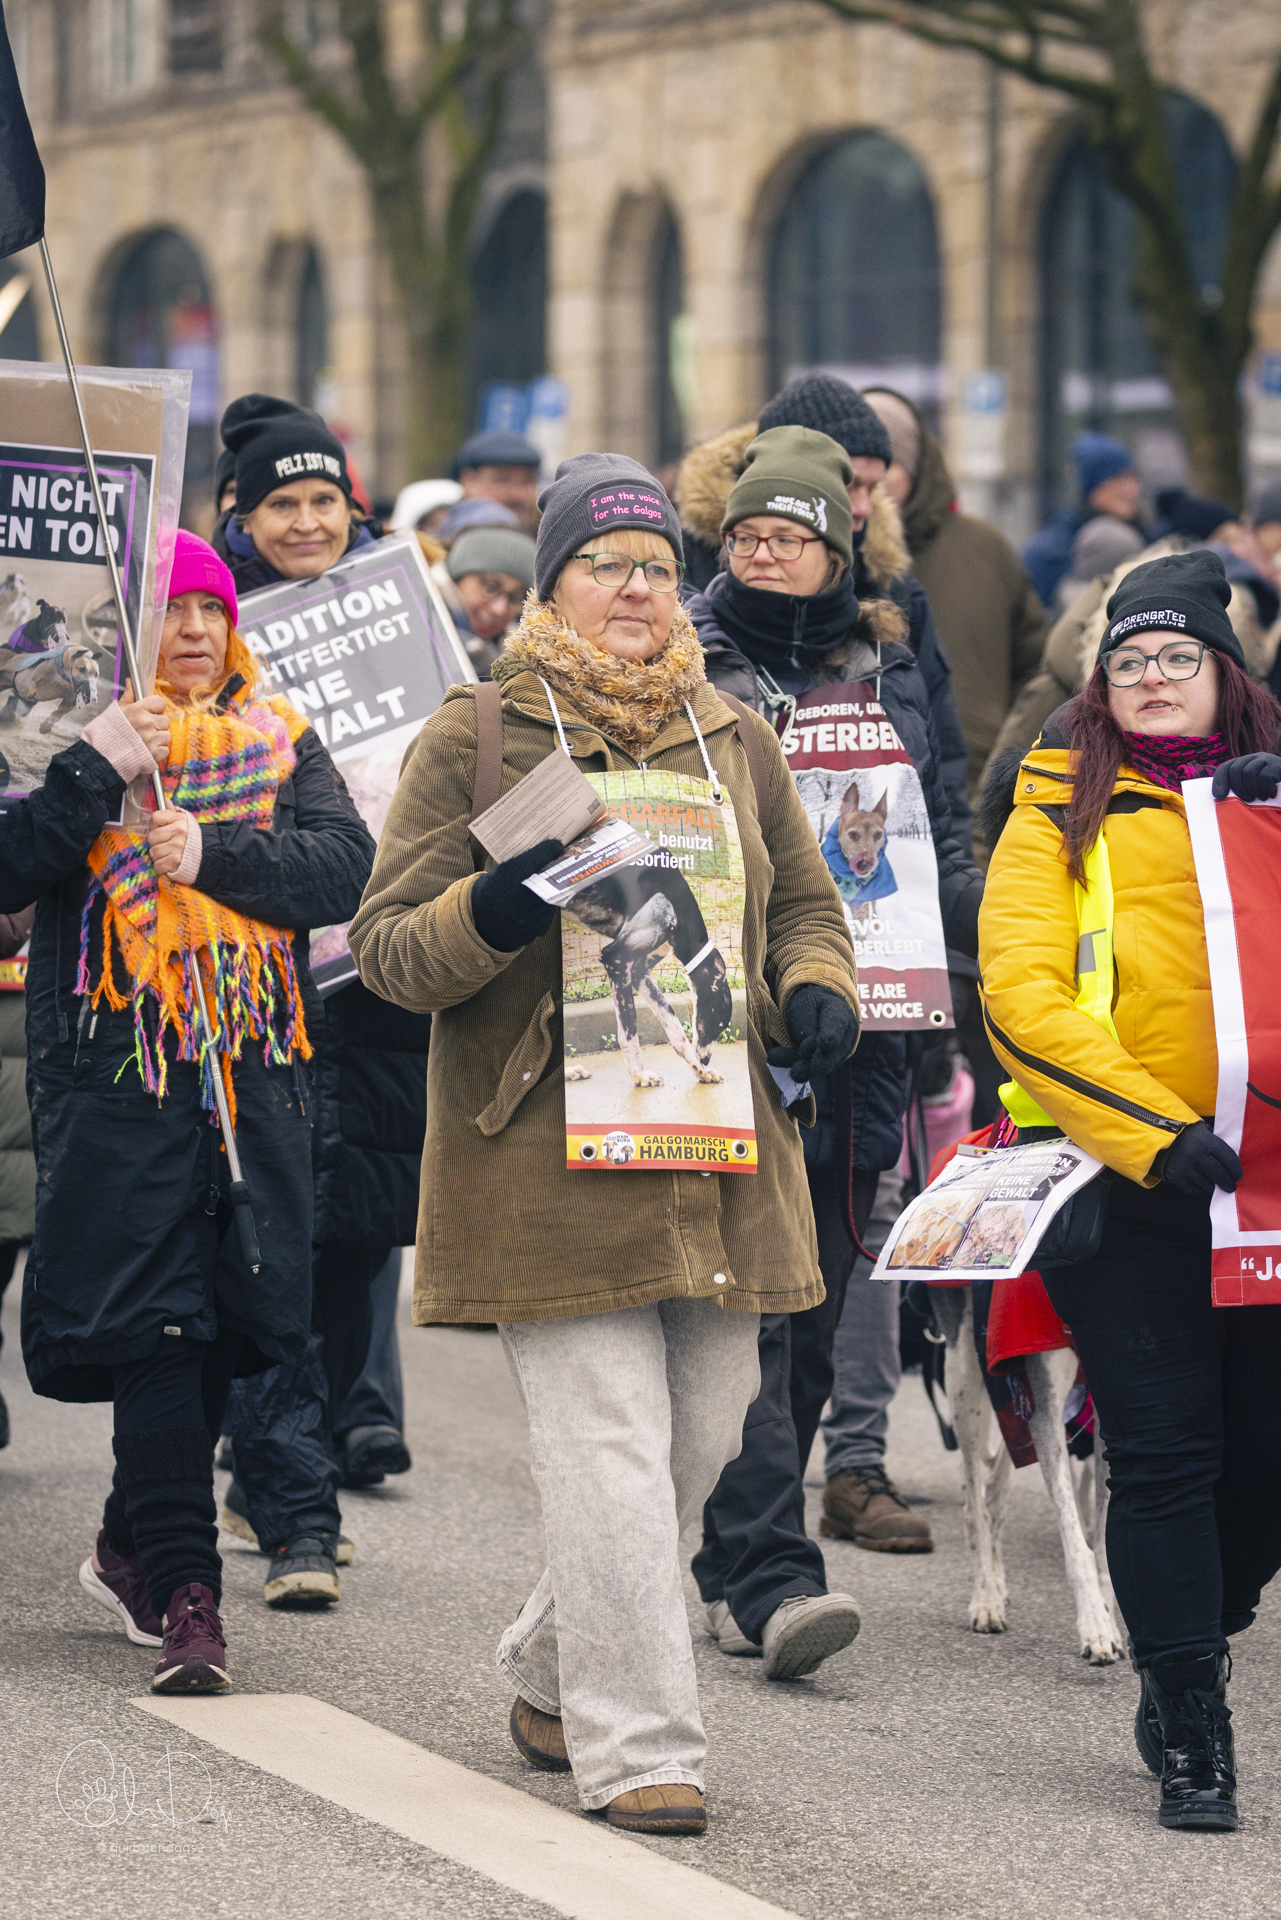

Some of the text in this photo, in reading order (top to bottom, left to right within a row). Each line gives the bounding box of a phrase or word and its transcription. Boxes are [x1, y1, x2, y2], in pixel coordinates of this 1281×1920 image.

[275, 454, 305, 479] PELZ
[303, 453, 324, 471] IST
[11, 474, 125, 517] NICHT
[590, 491, 661, 508] I am the voice
[794, 499, 811, 511] ARE
[593, 504, 662, 522] for the Galgos
[766, 501, 815, 521] THEIR VOICE
[45, 518, 120, 557] TOD
[244, 579, 403, 656] ADITION
[795, 703, 864, 721] GEBOREN,
[781, 721, 906, 756] STERBEN
[471, 809, 495, 828] Spaniens
[518, 773, 535, 788] Hunde
[592, 838, 629, 858] Spanien
[659, 830, 714, 851] benutzt
[555, 836, 643, 884] Ende der Jagdsaison
[569, 841, 647, 884] WEGGEWORFEN
[628, 851, 695, 870] sortiert!
[857, 982, 908, 999] E ARE
[868, 1002, 925, 1019] VOICE
[639, 1145, 729, 1162] HAMBURG
[1013, 1156, 1073, 1168] TRADITION
[1004, 1165, 1065, 1176] RECHTFERTIGT
[995, 1175, 1034, 1186] KEINE
[989, 1187, 1039, 1199] GEWALT
